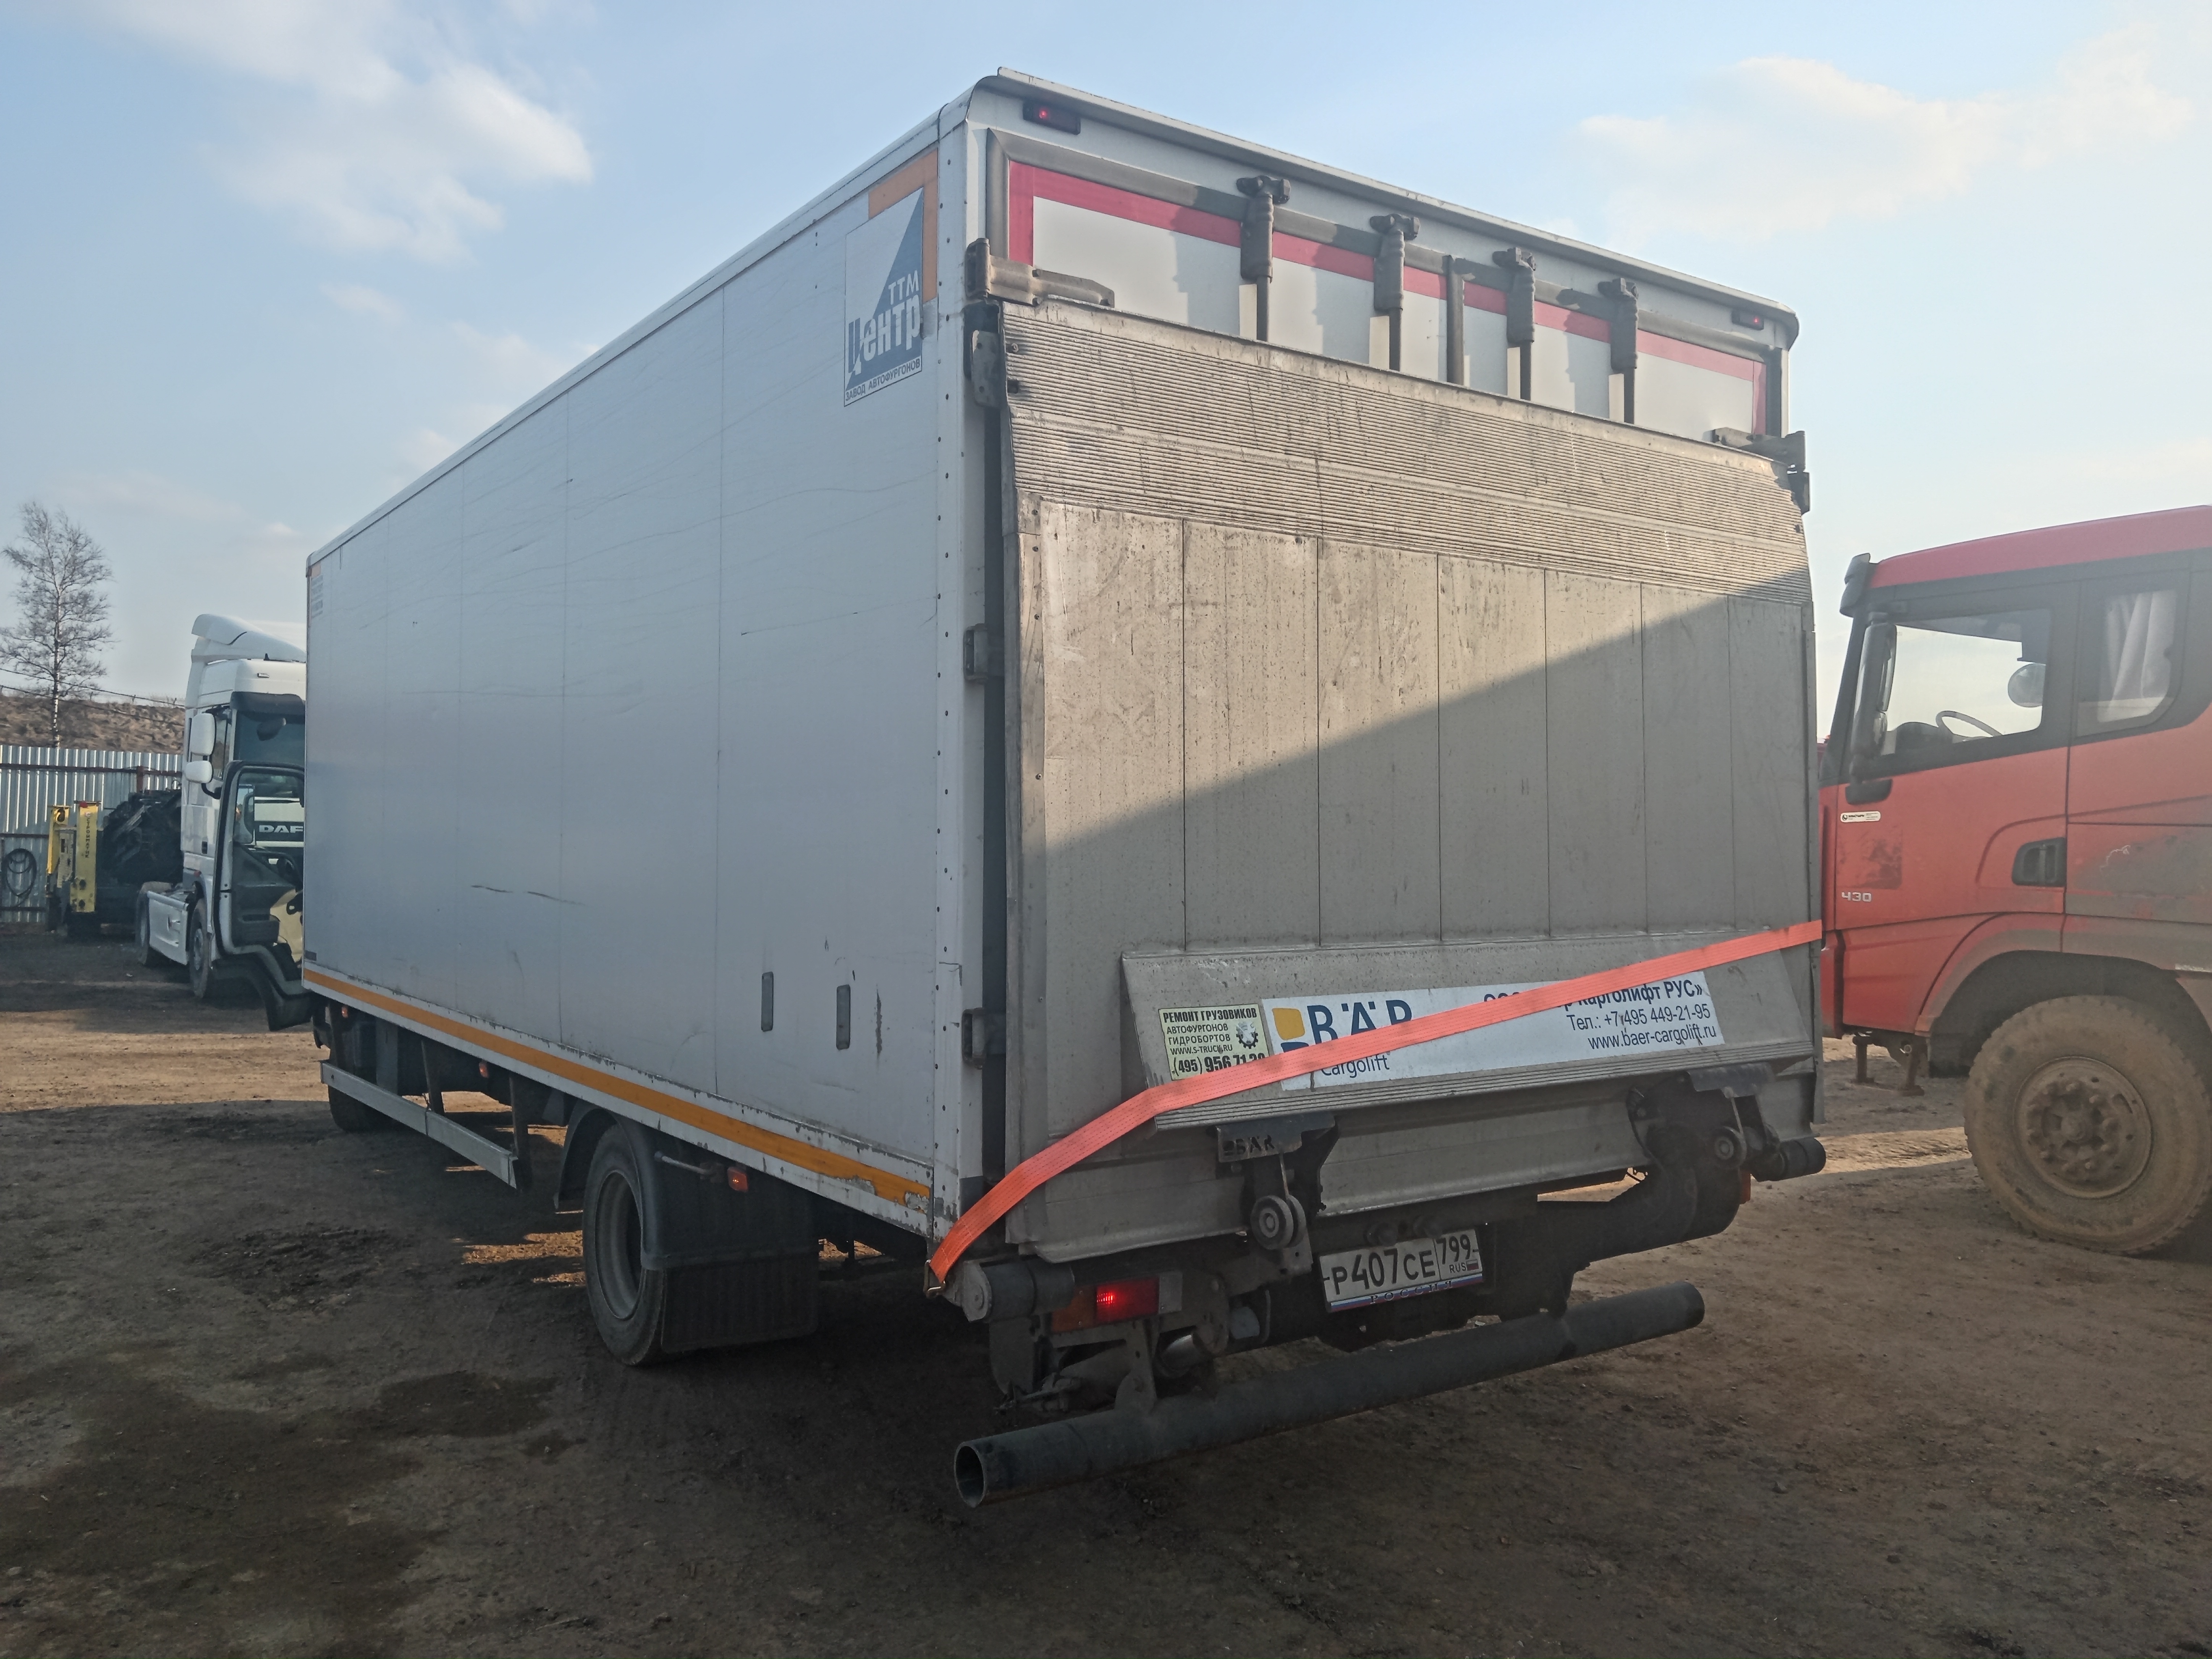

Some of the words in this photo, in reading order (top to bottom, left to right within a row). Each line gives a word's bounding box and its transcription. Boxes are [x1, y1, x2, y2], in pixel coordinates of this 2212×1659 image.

[888, 270, 919, 305] ТТМ
[846, 384, 866, 401] ЗАВОД
[868, 358, 920, 390] АВТОФУРГОНОВ
[259, 825, 303, 833] DAF
[1842, 892, 1871, 902] 430
[1663, 980, 1703, 999] РУС»
[1163, 1011, 1198, 1023] РЕМОНТ
[1201, 1008, 1257, 1021] ГРУЗОВИКОВ
[1566, 1014, 1601, 1031] Тел.:
[1604, 1011, 1618, 1027] +7
[1624, 1009, 1647, 1025] 495
[1651, 1003, 1711, 1023] 449-21-95
[1167, 1024, 1228, 1034] АВТОФУРГОНОВ
[1588, 1024, 1717, 1049] www.baer-cargolift.ru
[1169, 1034, 1231, 1046] ГИДРОБОРТОВ
[1170, 1045, 1233, 1055] WWW.S-TRUCK.RU
[1174, 1056, 1202, 1077] (495)
[1204, 1055, 1231, 1072] 956
[1436, 1234, 1471, 1265] 799
[1449, 1262, 1467, 1274] RUS
[1370, 1281, 1453, 1304] РОССИЯ
